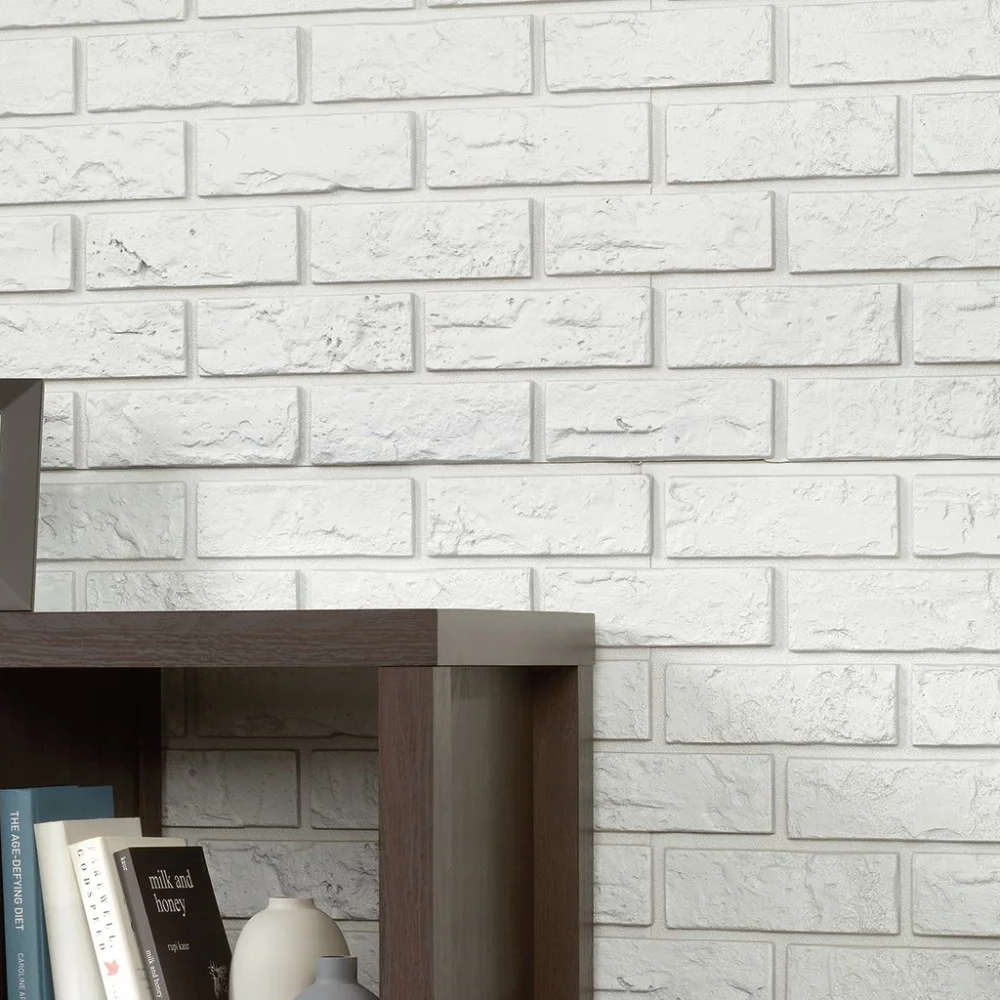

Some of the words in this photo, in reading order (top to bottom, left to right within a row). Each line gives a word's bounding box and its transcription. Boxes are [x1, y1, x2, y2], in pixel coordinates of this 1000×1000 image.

[10, 811, 20, 832] THE
[11, 834, 23, 904] AGE-DEFYING
[148, 870, 174, 890] milk
[174, 870, 194, 889] and
[153, 893, 186, 916] honey
[14, 907, 24, 931] DIET
[146, 950, 154, 964] milk
[168, 941, 178, 953] rupi
[178, 941, 190, 950] kaur
[18, 952, 26, 991] CAROLINE
[150, 965, 159, 978] and
[153, 977, 162, 998] honey
